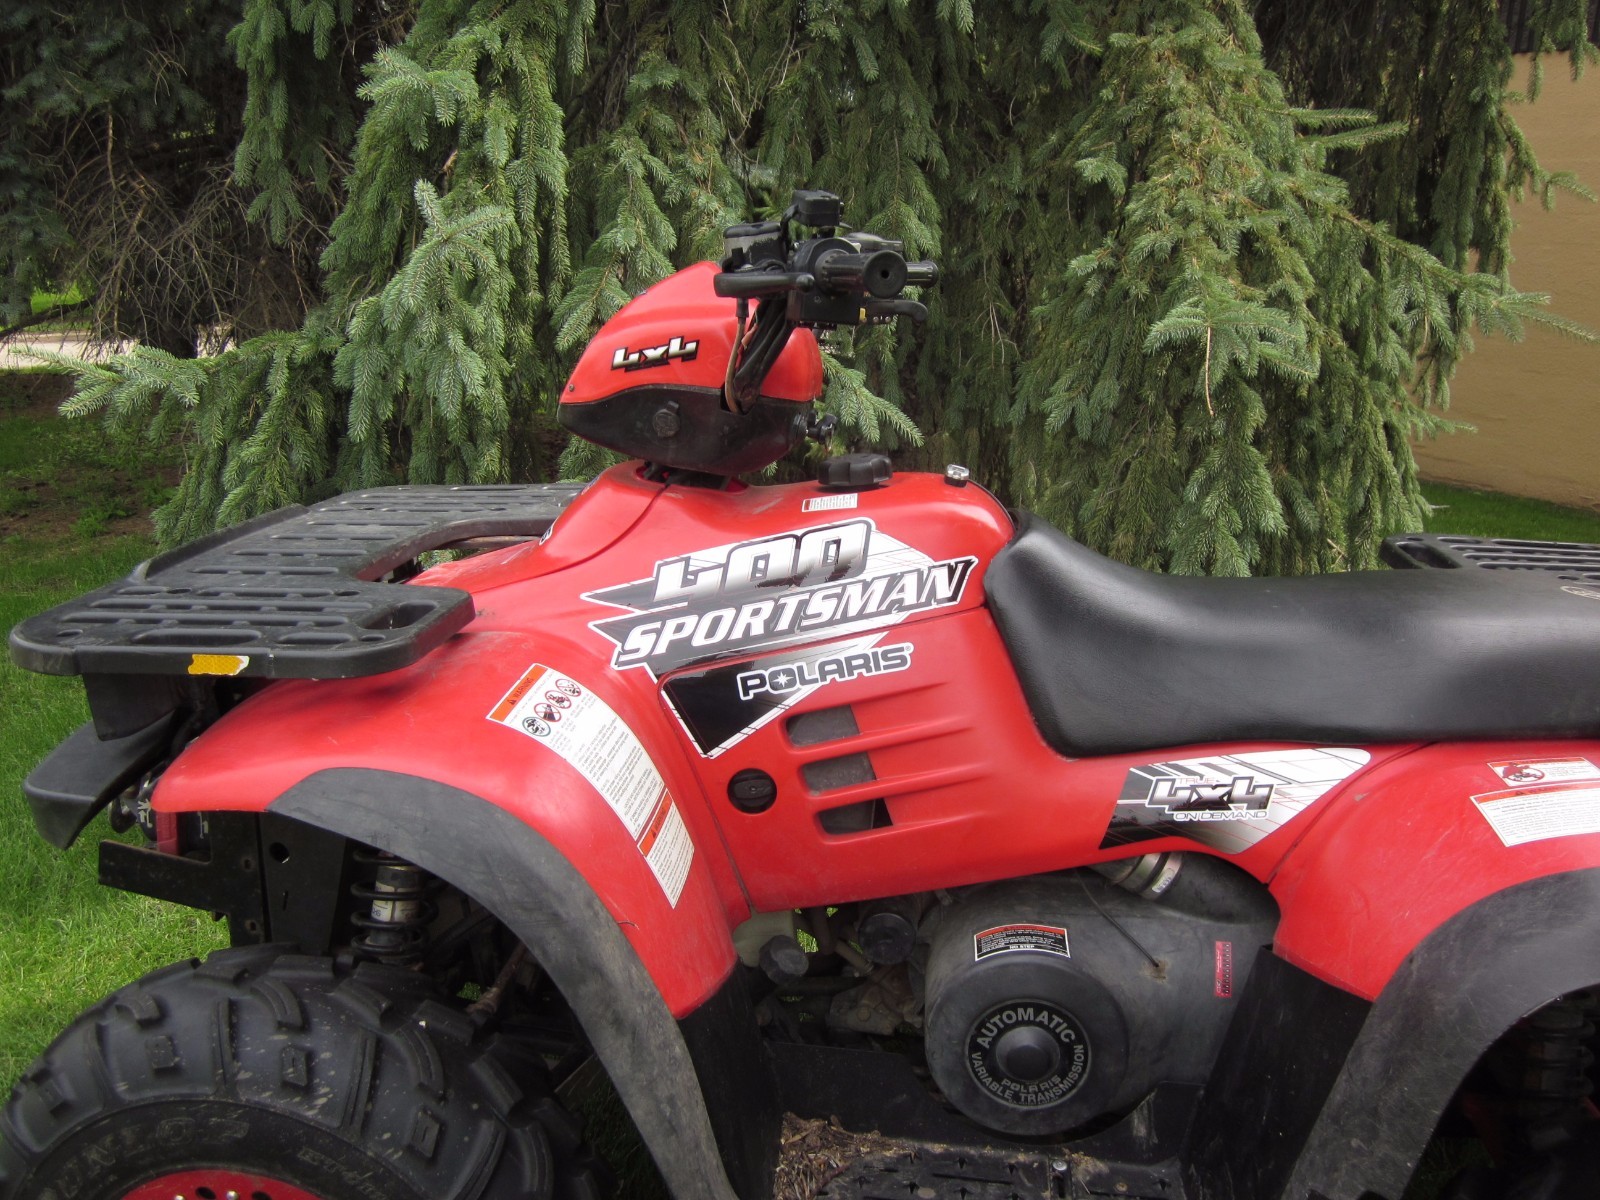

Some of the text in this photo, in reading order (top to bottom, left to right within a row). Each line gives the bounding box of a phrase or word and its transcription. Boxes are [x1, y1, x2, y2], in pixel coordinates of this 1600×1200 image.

[652, 520, 871, 602] 400
[618, 558, 974, 664] SPORTSMAN
[1175, 810, 1267, 820] ON DEMAND
[977, 1008, 1076, 1049] AUTOMATIC
[972, 1045, 1084, 1104] VARIABLE TRANSMISSION
[1001, 1075, 1061, 1093] POLARIS
